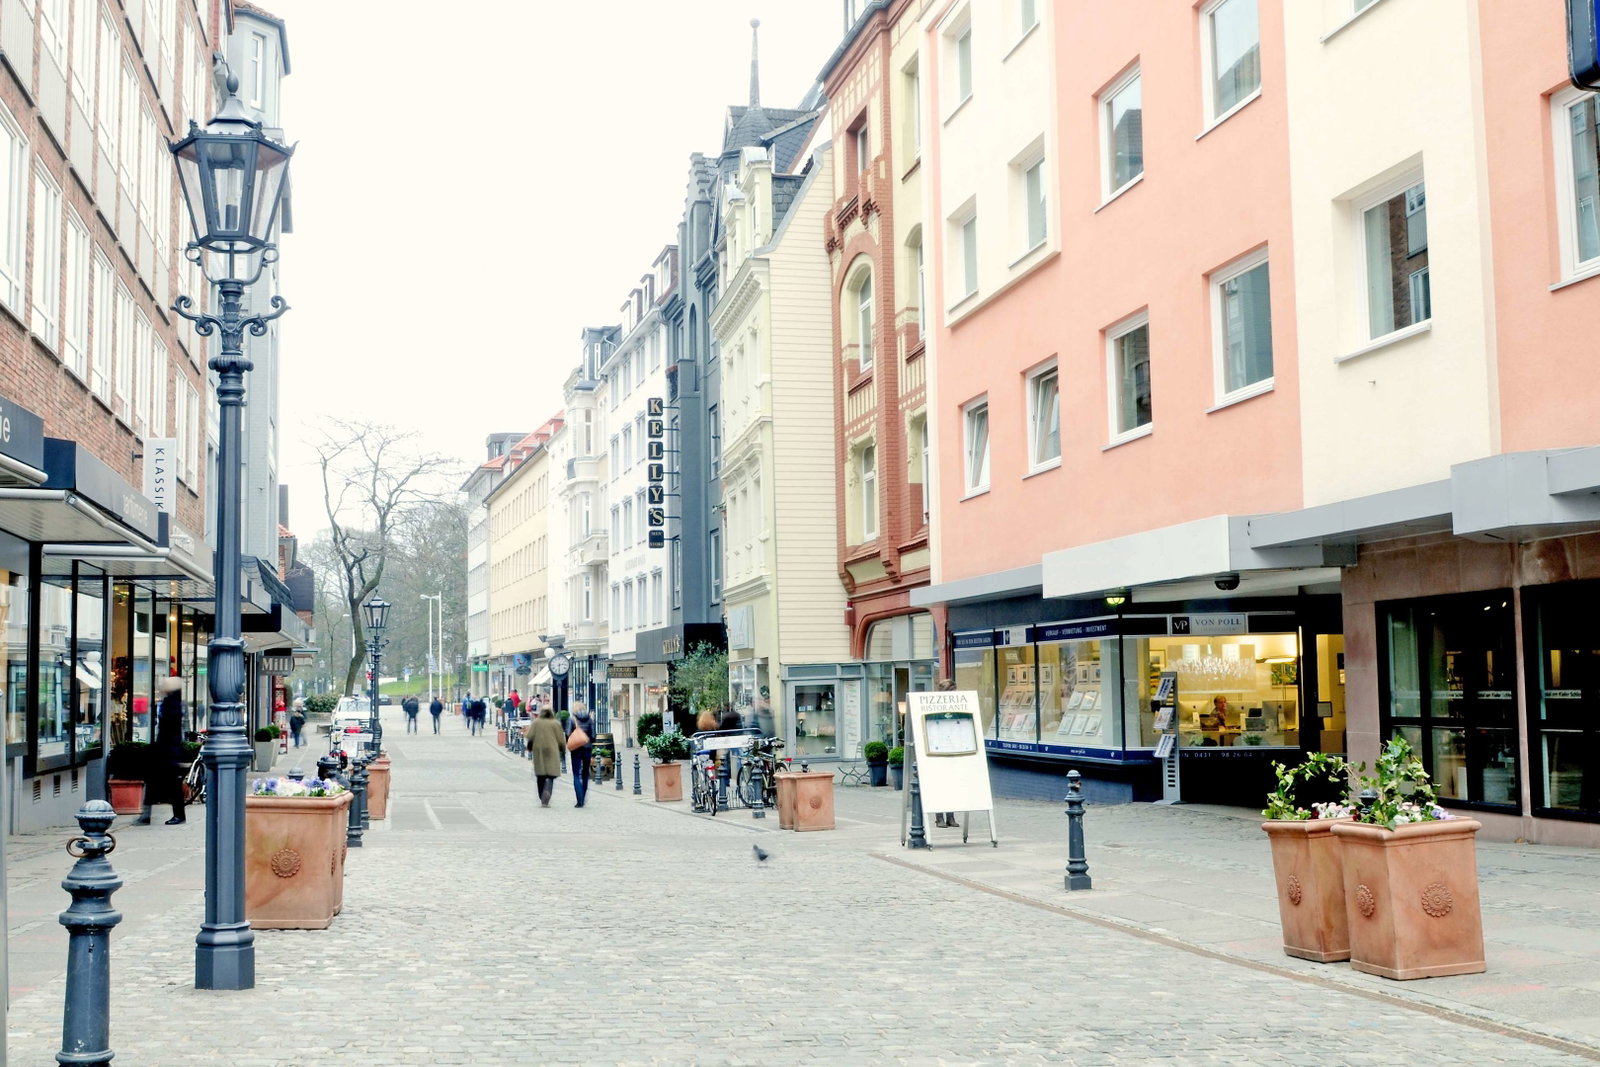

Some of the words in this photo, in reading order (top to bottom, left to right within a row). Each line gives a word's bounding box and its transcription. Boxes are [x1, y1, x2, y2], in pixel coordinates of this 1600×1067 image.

[648, 399, 664, 526] KELLY'S
[155, 447, 165, 509] KLASSIK
[1195, 618, 1214, 626] VON
[1218, 618, 1242, 626] POLL
[919, 694, 968, 704] PIZZERIA
[920, 703, 969, 712] RISTORANTE
